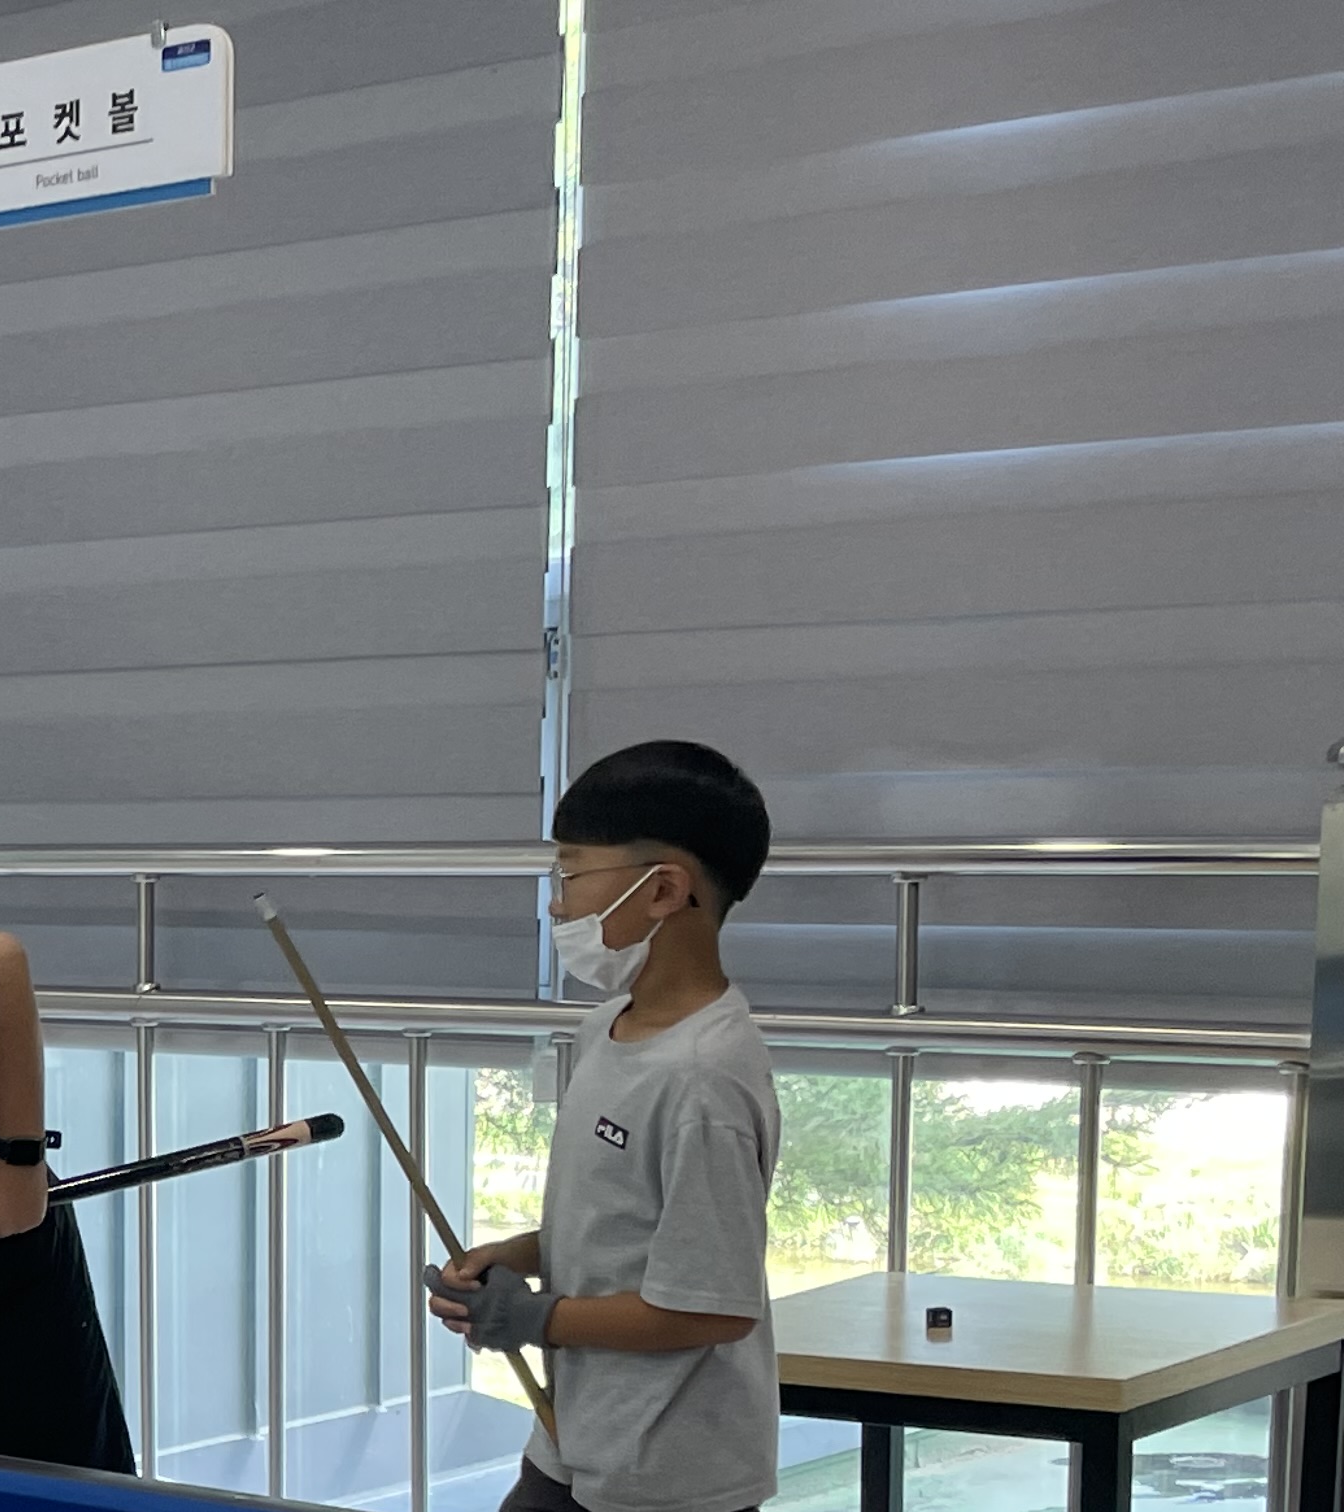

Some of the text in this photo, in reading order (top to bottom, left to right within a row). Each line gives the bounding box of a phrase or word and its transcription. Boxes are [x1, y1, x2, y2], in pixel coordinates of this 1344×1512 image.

[35, 164, 99, 190] Pocket ball
[596, 1123, 625, 1146] FILA
